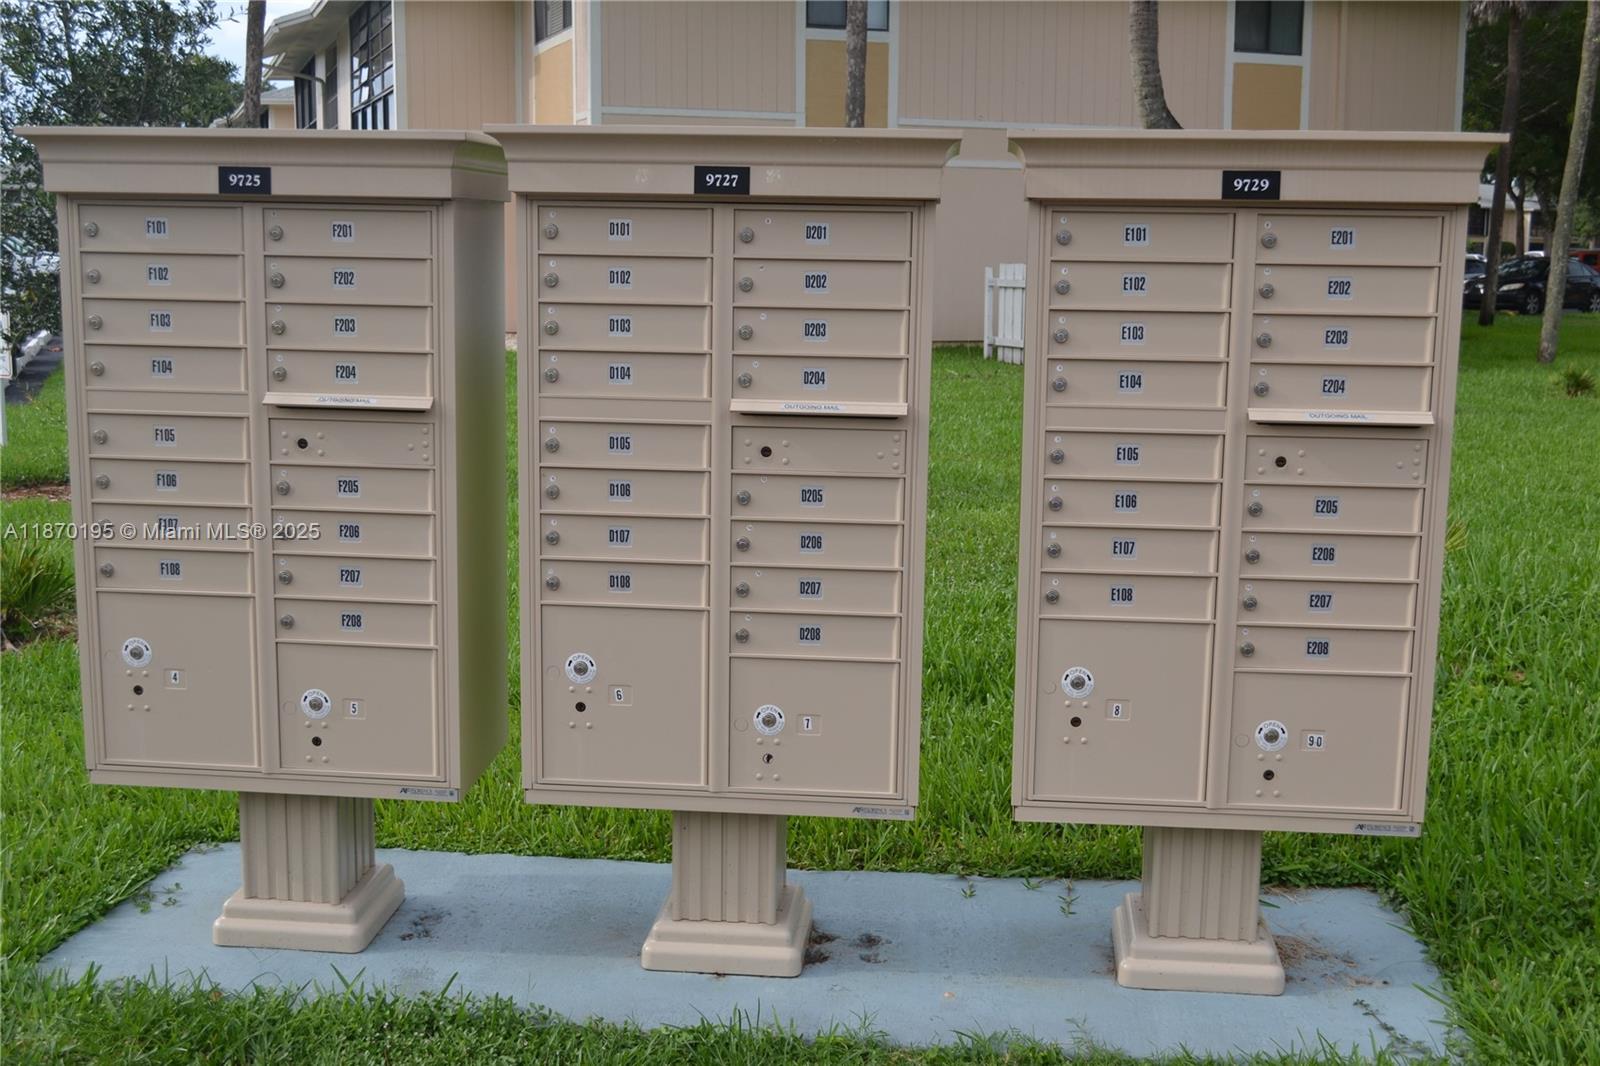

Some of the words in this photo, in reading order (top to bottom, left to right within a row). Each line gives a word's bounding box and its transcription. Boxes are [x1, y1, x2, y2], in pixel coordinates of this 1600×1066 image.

[229, 174, 261, 187] 9725
[705, 173, 739, 187] 9727
[1233, 178, 1270, 192] 9729
[146, 220, 166, 234] F101
[332, 223, 352, 238] F201
[609, 222, 630, 236] D101
[805, 225, 827, 240] D201
[1125, 227, 1147, 242] E101
[1331, 230, 1353, 245] E201
[148, 266, 169, 281] F102
[333, 271, 355, 286] F202
[609, 270, 631, 285] D102
[805, 274, 827, 289] D202
[1123, 276, 1146, 291] E102
[1327, 280, 1351, 295] E202
[150, 313, 171, 328] F103
[334, 318, 356, 333] F203
[609, 318, 631, 333] D103
[804, 322, 826, 337] D203
[1121, 326, 1144, 341] E103
[1325, 330, 1348, 345] E203
[151, 359, 173, 374] F104
[335, 364, 356, 379] F204
[609, 366, 631, 380] D104
[803, 370, 826, 385] D204
[1119, 374, 1142, 389] E104
[1322, 379, 1345, 394] E204
[154, 428, 175, 442] F105
[609, 436, 631, 450] D105
[1116, 447, 1139, 461] E105
[156, 473, 177, 488] F106
[338, 479, 359, 494] F205
[609, 483, 631, 497] D106
[801, 488, 823, 503] D205
[1114, 494, 1137, 509] E106
[1315, 499, 1338, 514] E205
[339, 524, 360, 539] F206
[609, 529, 630, 543] D107
[800, 535, 822, 550] D206
[1112, 540, 1135, 555] E107
[1312, 546, 1335, 561] E206
[160, 562, 181, 576] F108
[340, 569, 361, 583] F207
[609, 574, 631, 589] D108
[799, 581, 822, 595] D207
[1111, 587, 1133, 602] E108
[1309, 594, 1332, 608] E207
[341, 614, 362, 628] F208
[799, 627, 821, 641] D208
[1306, 641, 1329, 655] E208
[172, 672, 178, 682] 4
[615, 689, 622, 701] 6
[351, 703, 358, 714] 5
[760, 706, 778, 714] OPEN
[1114, 705, 1120, 716] 8
[805, 718, 811, 729] 7
